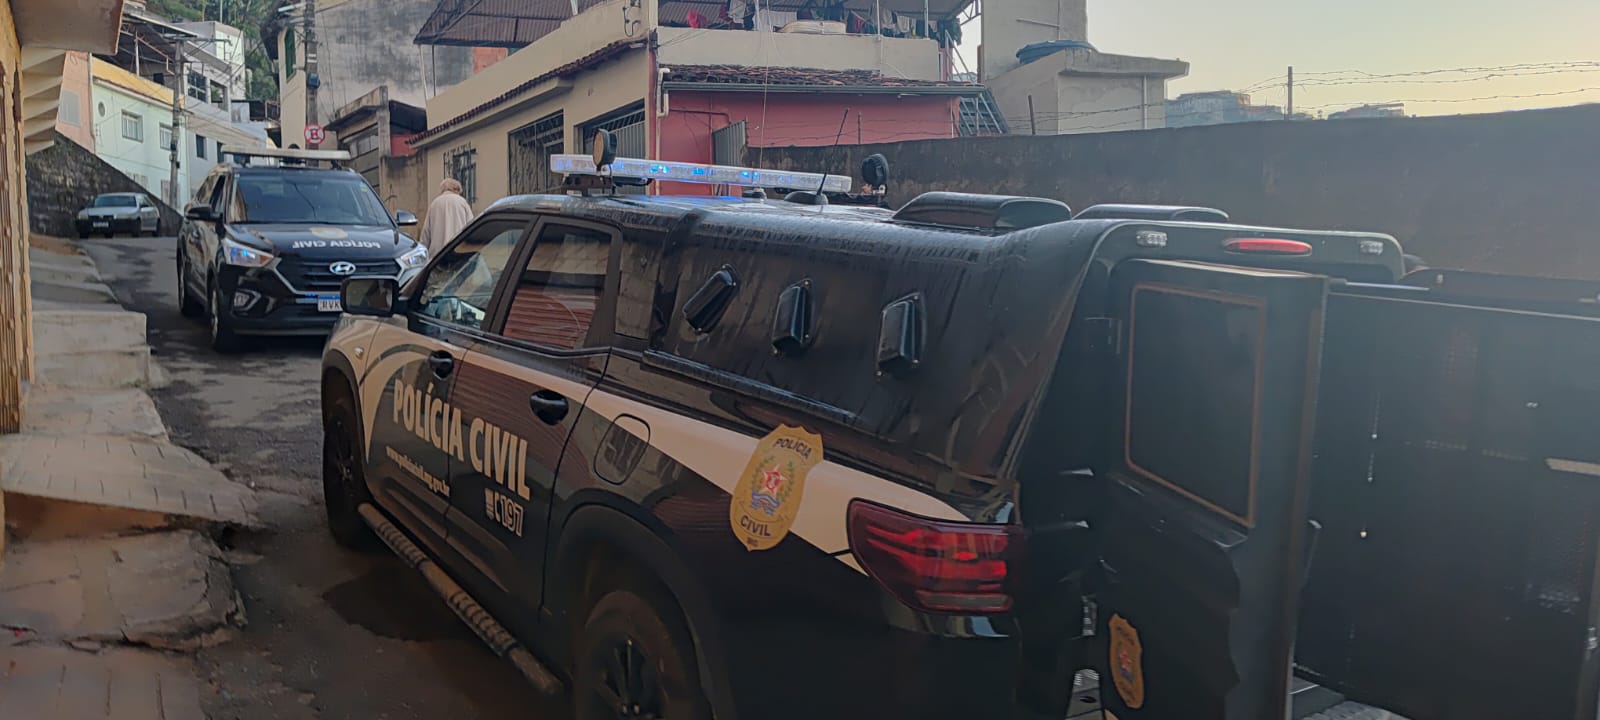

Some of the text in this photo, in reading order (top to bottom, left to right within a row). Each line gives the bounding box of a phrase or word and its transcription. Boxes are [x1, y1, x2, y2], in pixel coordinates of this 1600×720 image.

[322, 300, 341, 310] RVK
[393, 378, 530, 501] POLÍCIA CIVIL
[740, 515, 771, 537] CIVIL
